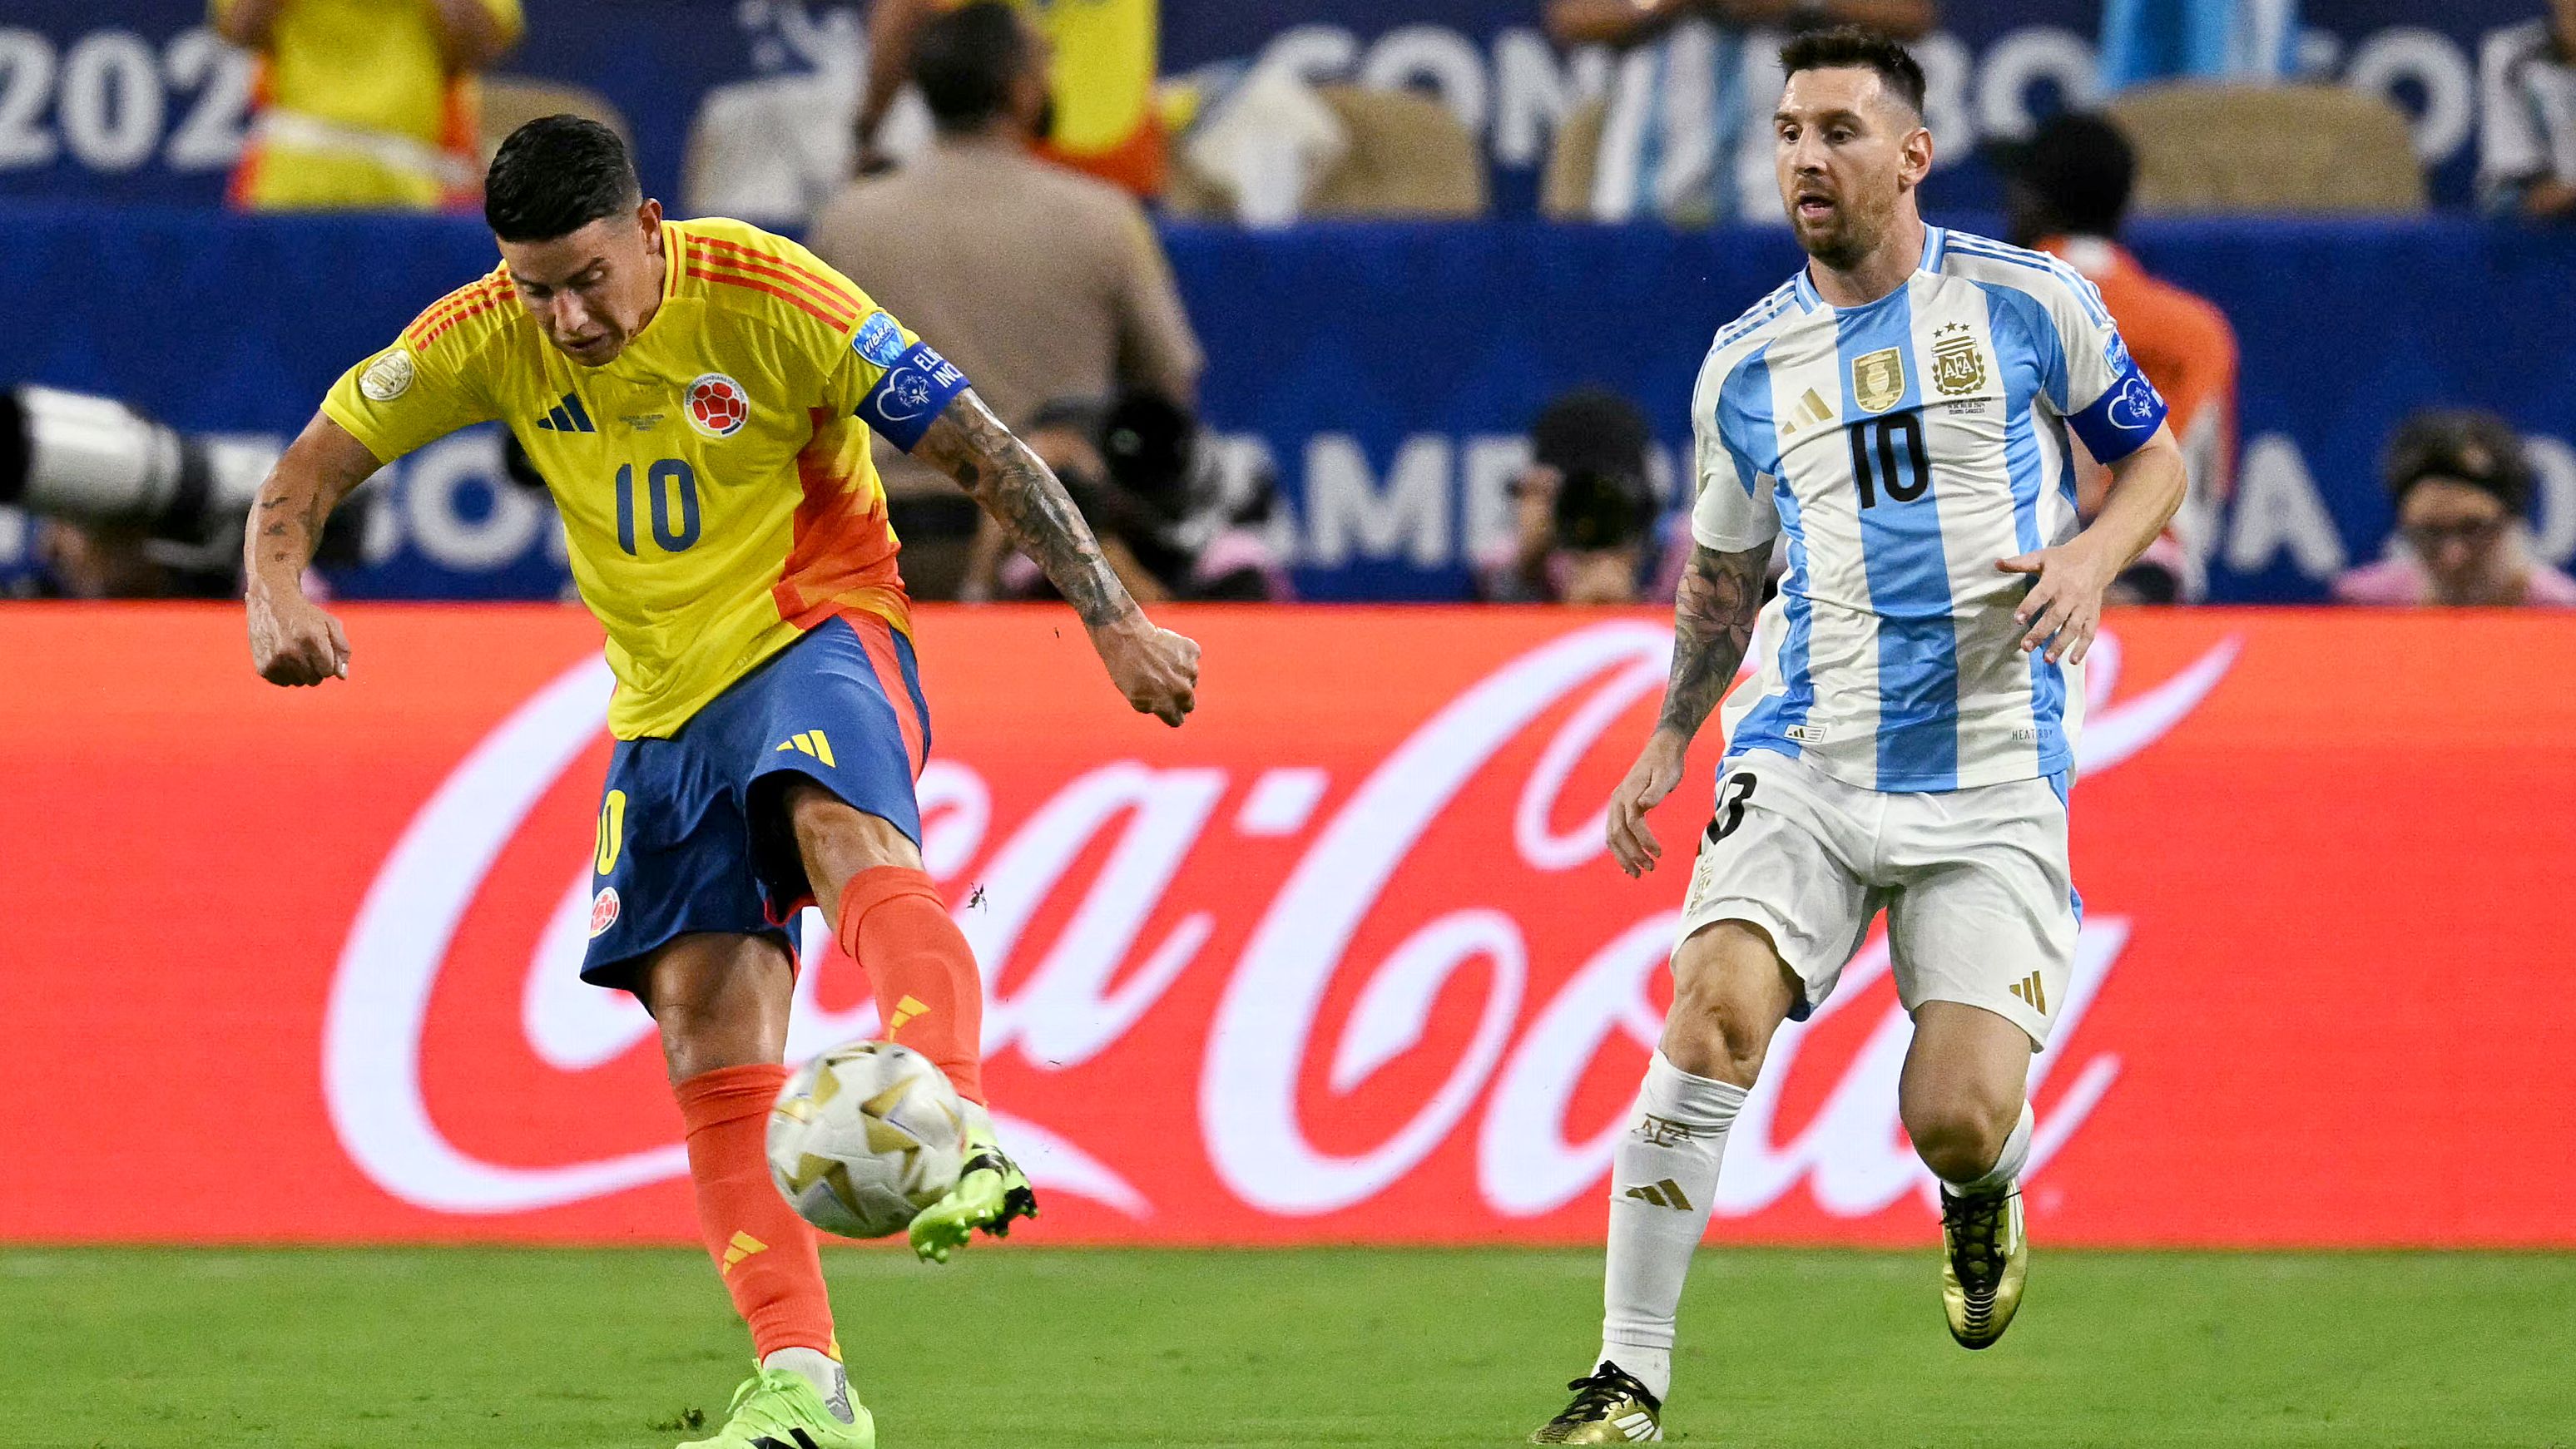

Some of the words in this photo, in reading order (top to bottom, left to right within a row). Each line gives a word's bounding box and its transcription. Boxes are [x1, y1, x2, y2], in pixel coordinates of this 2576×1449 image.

[863, 321, 893, 354] VIBRA
[1944, 351, 1974, 379] AFA
[1850, 413, 1931, 510] 10
[615, 458, 701, 556] 10
[593, 789, 626, 875] 0
